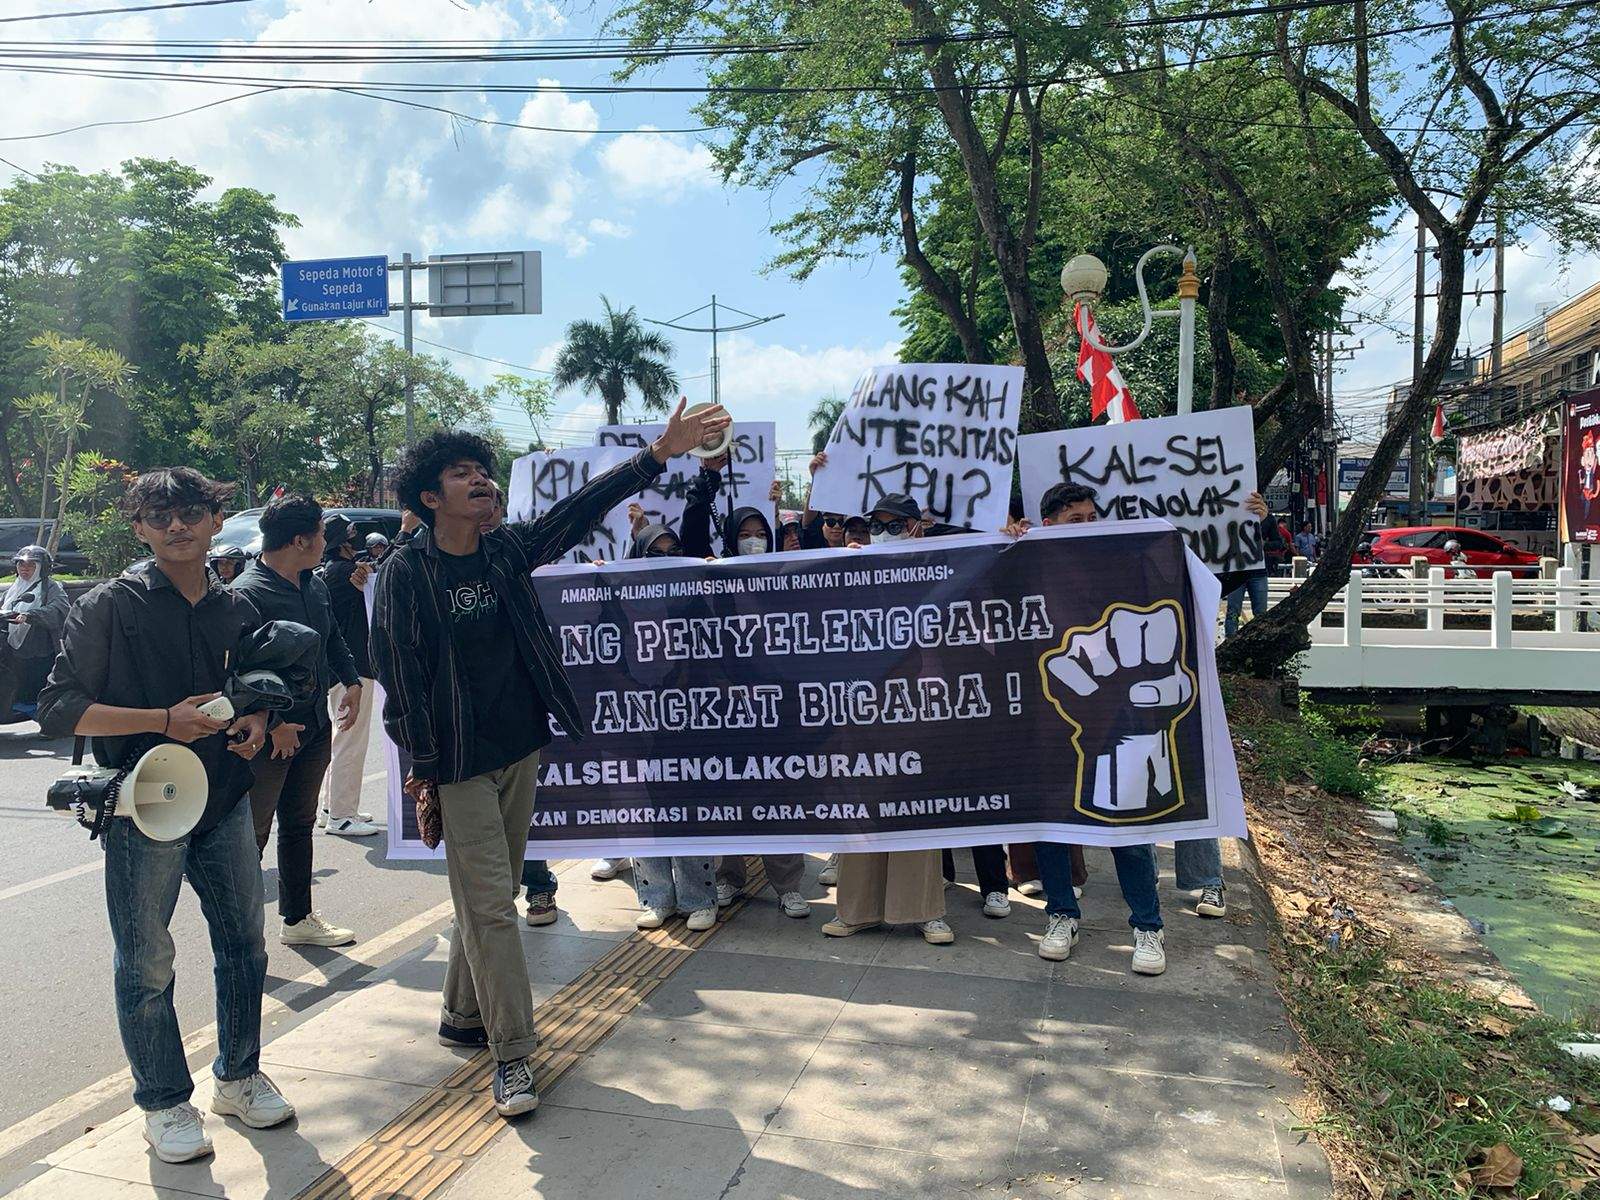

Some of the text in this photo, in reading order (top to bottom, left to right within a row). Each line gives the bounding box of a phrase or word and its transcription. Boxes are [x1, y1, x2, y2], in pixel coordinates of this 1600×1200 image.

[299, 265, 384, 283] Sepeda Motor &
[322, 282, 363, 297] Sepeda
[301, 297, 383, 312] Gunakan Lajur Kiri
[561, 586, 612, 603] AMARAH
[669, 578, 745, 597] MAHASISWA
[747, 576, 789, 592] UNTUK
[792, 572, 841, 590] RAKYAT
[844, 570, 871, 587] DAN
[634, 594, 1054, 663] PENYELENGGARA
[591, 684, 783, 735] ANGKAT
[798, 672, 992, 727] BICARA
[1006, 672, 1022, 716] !
[576, 805, 689, 826] DEMOKRASI
[697, 805, 743, 822] DARI
[752, 803, 870, 821] CARA-CARA
[879, 794, 1011, 818] MANIPULASI
